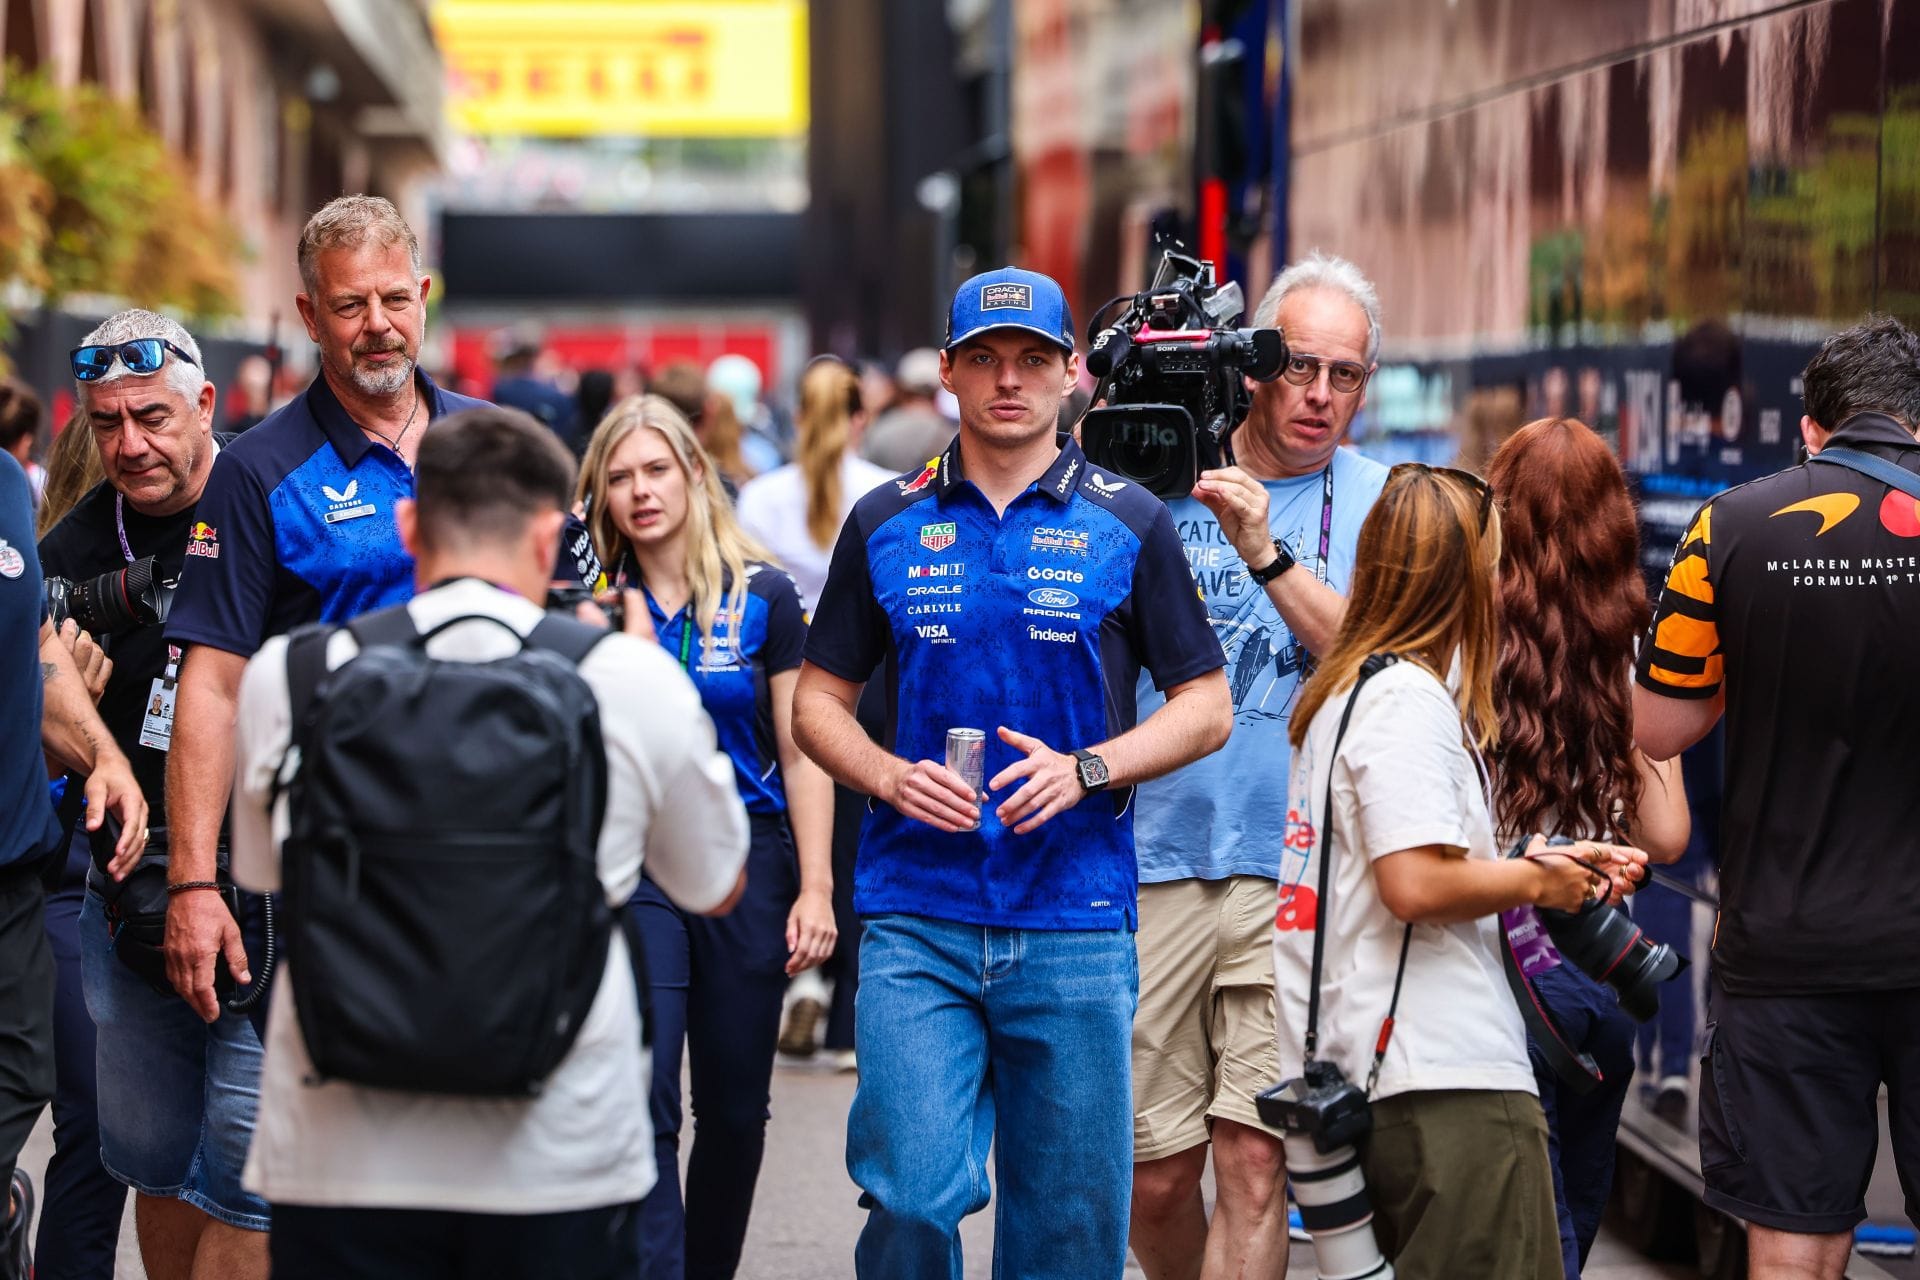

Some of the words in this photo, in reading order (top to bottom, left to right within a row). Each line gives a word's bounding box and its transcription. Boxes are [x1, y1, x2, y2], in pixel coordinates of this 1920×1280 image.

[986, 286, 1026, 295] ORACLE
[1056, 459, 1079, 494] DAMAC
[1084, 482, 1115, 499] CASTORE
[328, 499, 362, 511] CASTORE
[924, 525, 953, 535] TAG
[1034, 528, 1089, 540] ORACLE
[1178, 520, 1231, 546] CATC
[197, 541, 220, 558] Bull
[922, 535, 955, 550] HEUER
[1031, 546, 1087, 557] RACING
[1187, 546, 1221, 567] THE
[1767, 559, 1850, 571] McLAREN
[1861, 557, 1916, 569] MASTE
[908, 564, 948, 579] Mobil
[1042, 568, 1084, 584] Gate
[1198, 570, 1241, 597] AVE
[1793, 575, 1877, 586] FORMULA
[906, 585, 963, 596] ORACLE
[1037, 592, 1069, 606] Ford
[907, 603, 962, 615] CARLYLE
[1023, 608, 1081, 620] RACING
[914, 624, 949, 638] VISA
[1027, 625, 1077, 643] indeed
